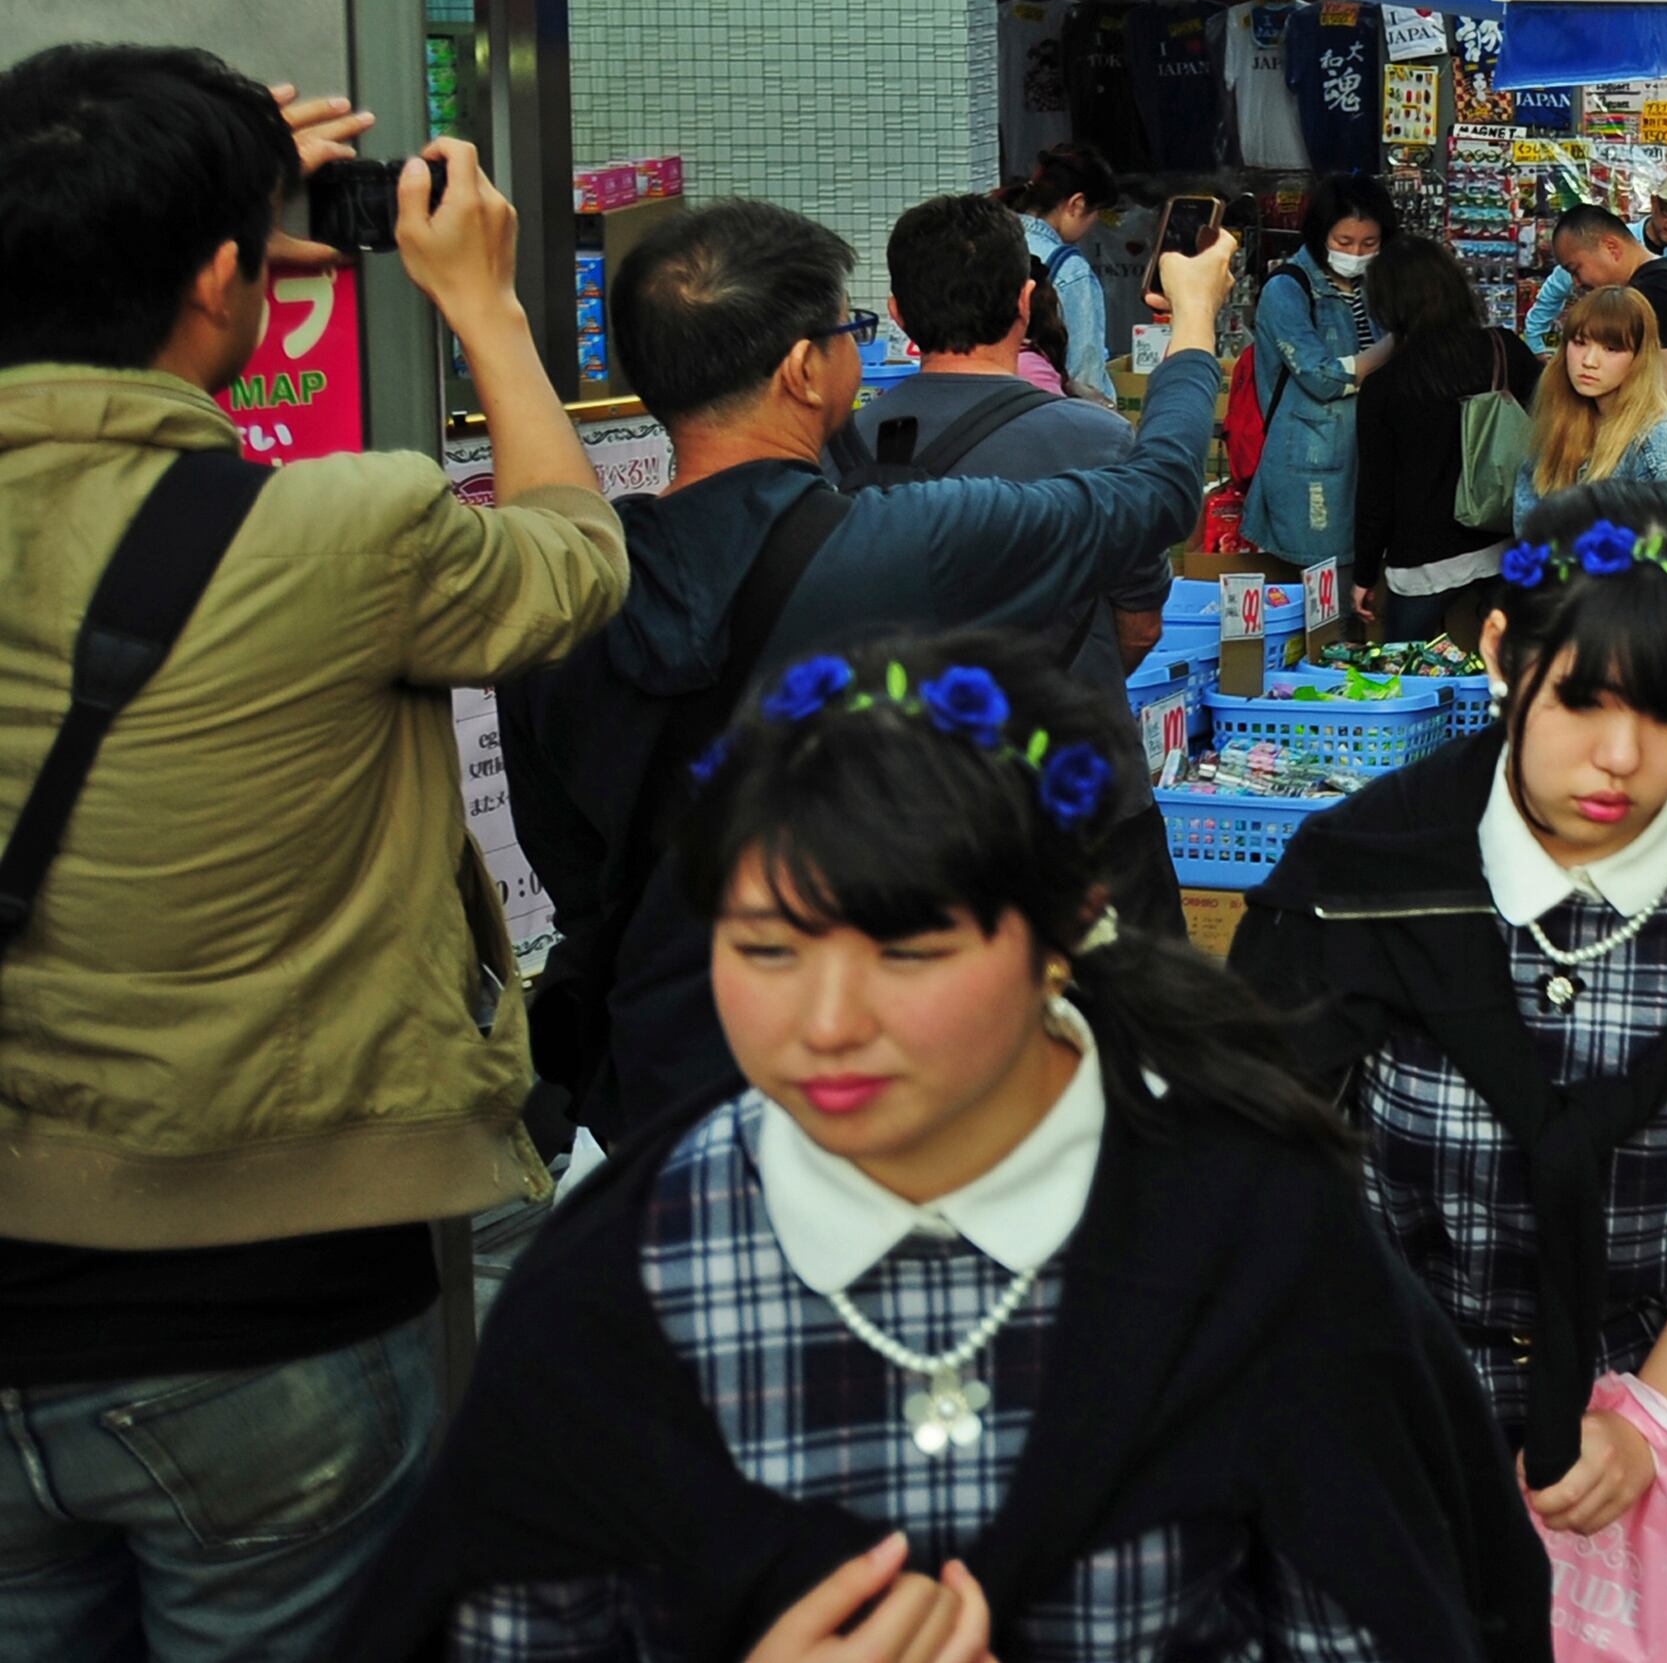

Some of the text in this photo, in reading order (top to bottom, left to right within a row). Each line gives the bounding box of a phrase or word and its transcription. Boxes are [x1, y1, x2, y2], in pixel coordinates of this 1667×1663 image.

[1386, 25, 1445, 47] JAPAN
[1086, 53, 1122, 68] TOK
[1251, 55, 1282, 70] JAP
[1156, 61, 1210, 77] JAPAN
[1515, 91, 1571, 108] JAPAN
[1458, 125, 1518, 139] MAGNET
[231, 369, 328, 411] MAP
[478, 732, 501, 751] eg
